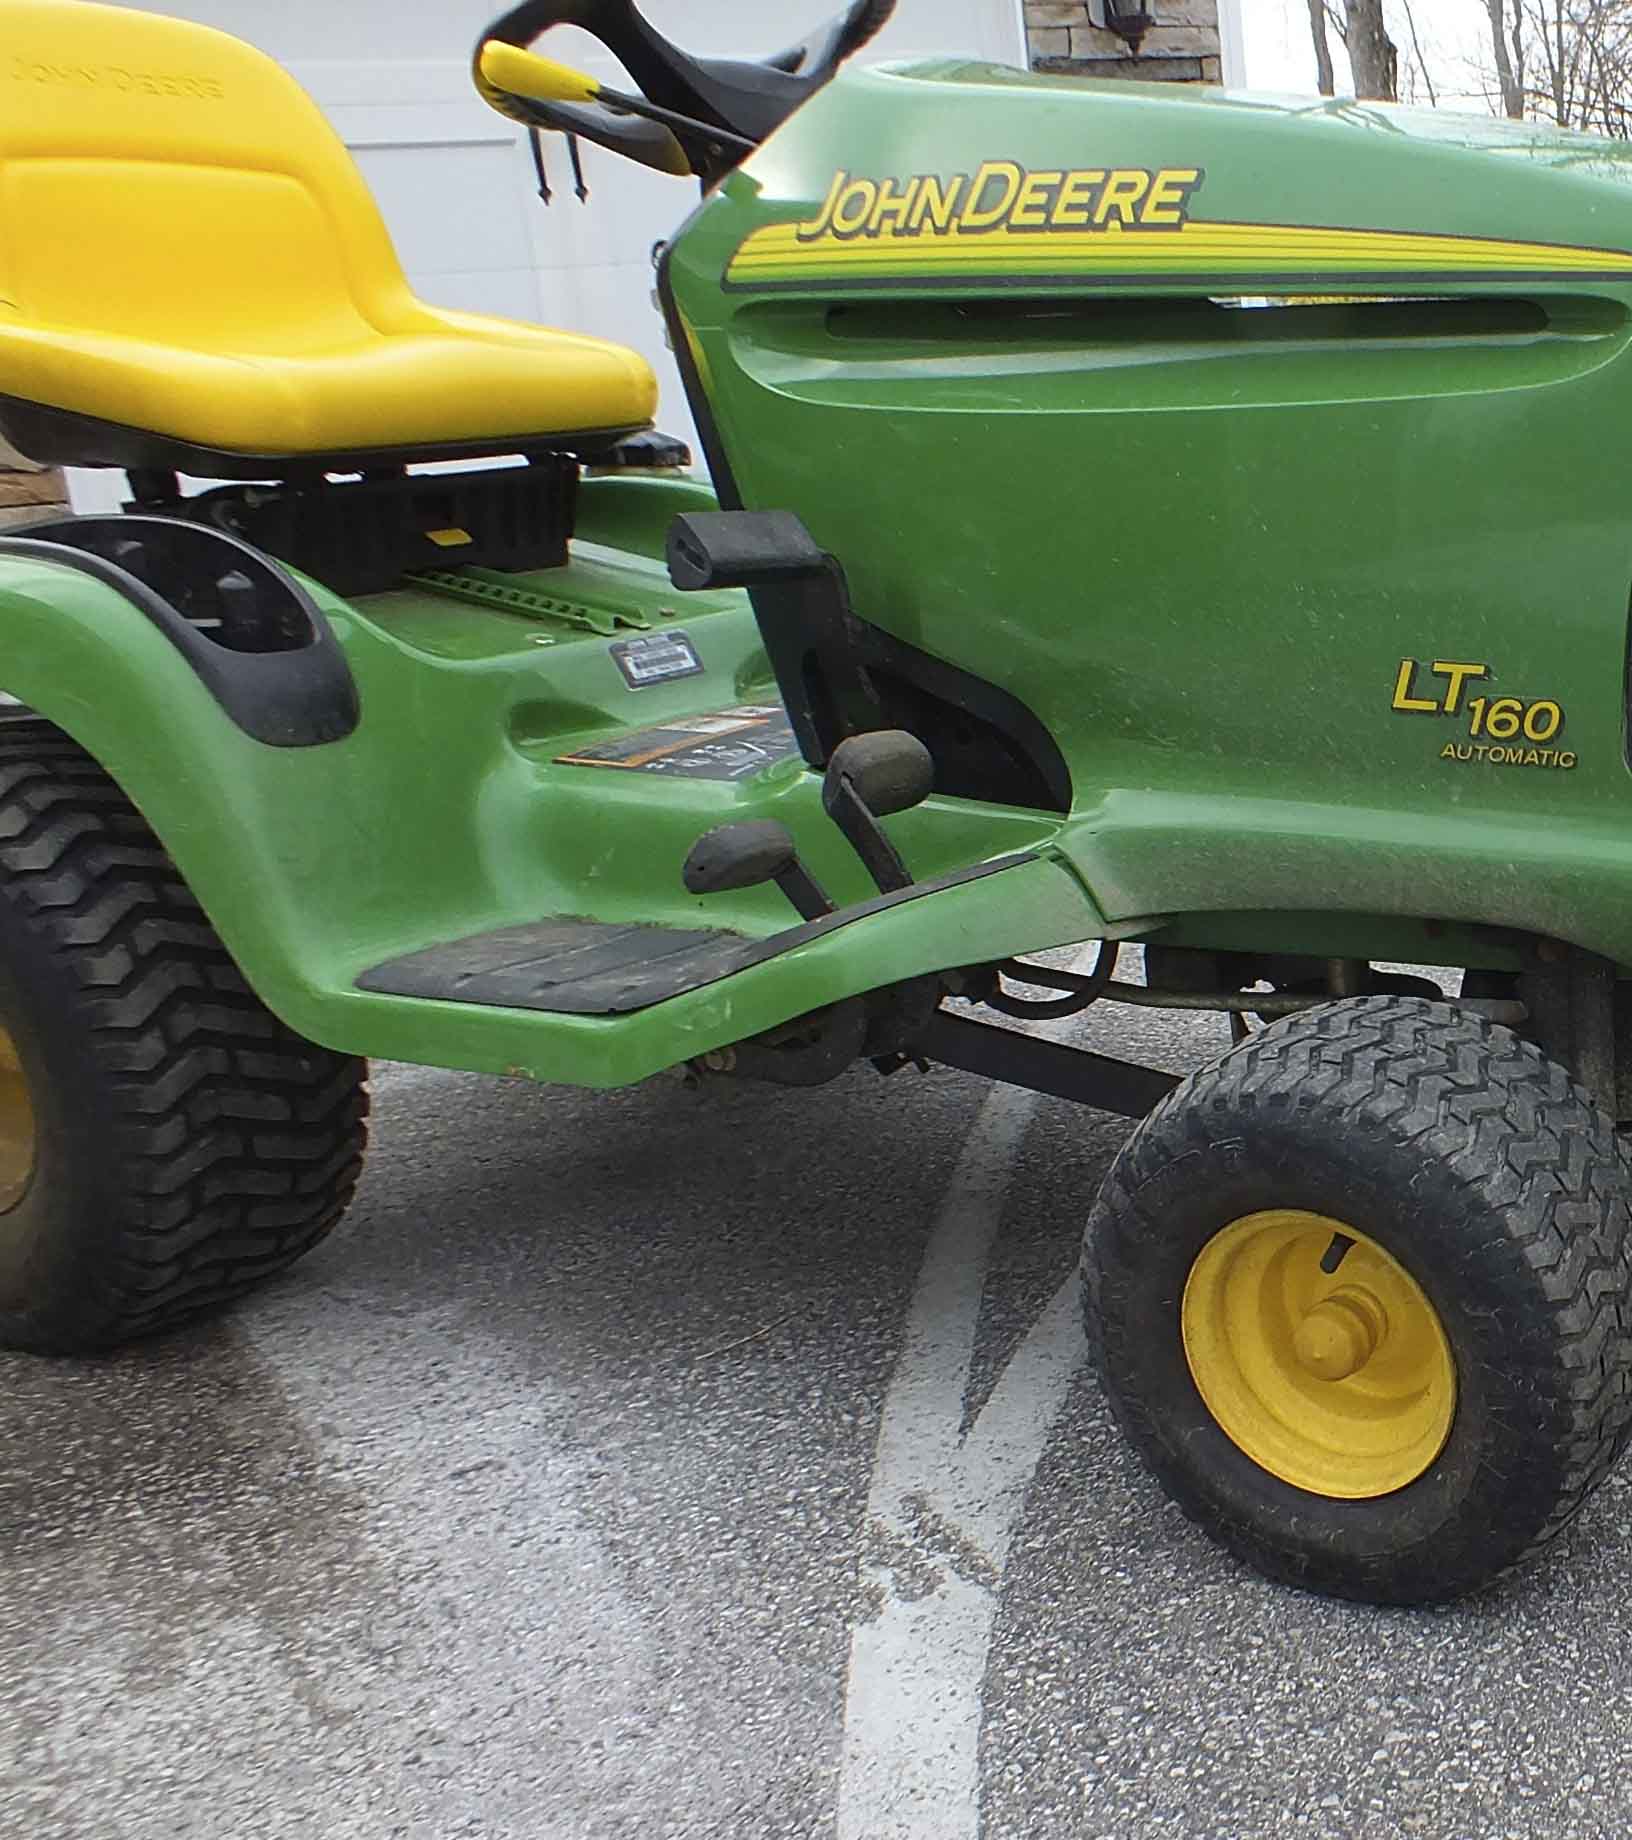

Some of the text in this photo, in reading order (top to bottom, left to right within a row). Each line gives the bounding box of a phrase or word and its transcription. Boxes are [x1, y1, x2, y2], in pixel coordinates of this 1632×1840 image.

[797, 160, 1203, 241] JOHN DEERE
[1392, 658, 1563, 744] LT 160
[1439, 743, 1578, 769] AUTOMATIC
